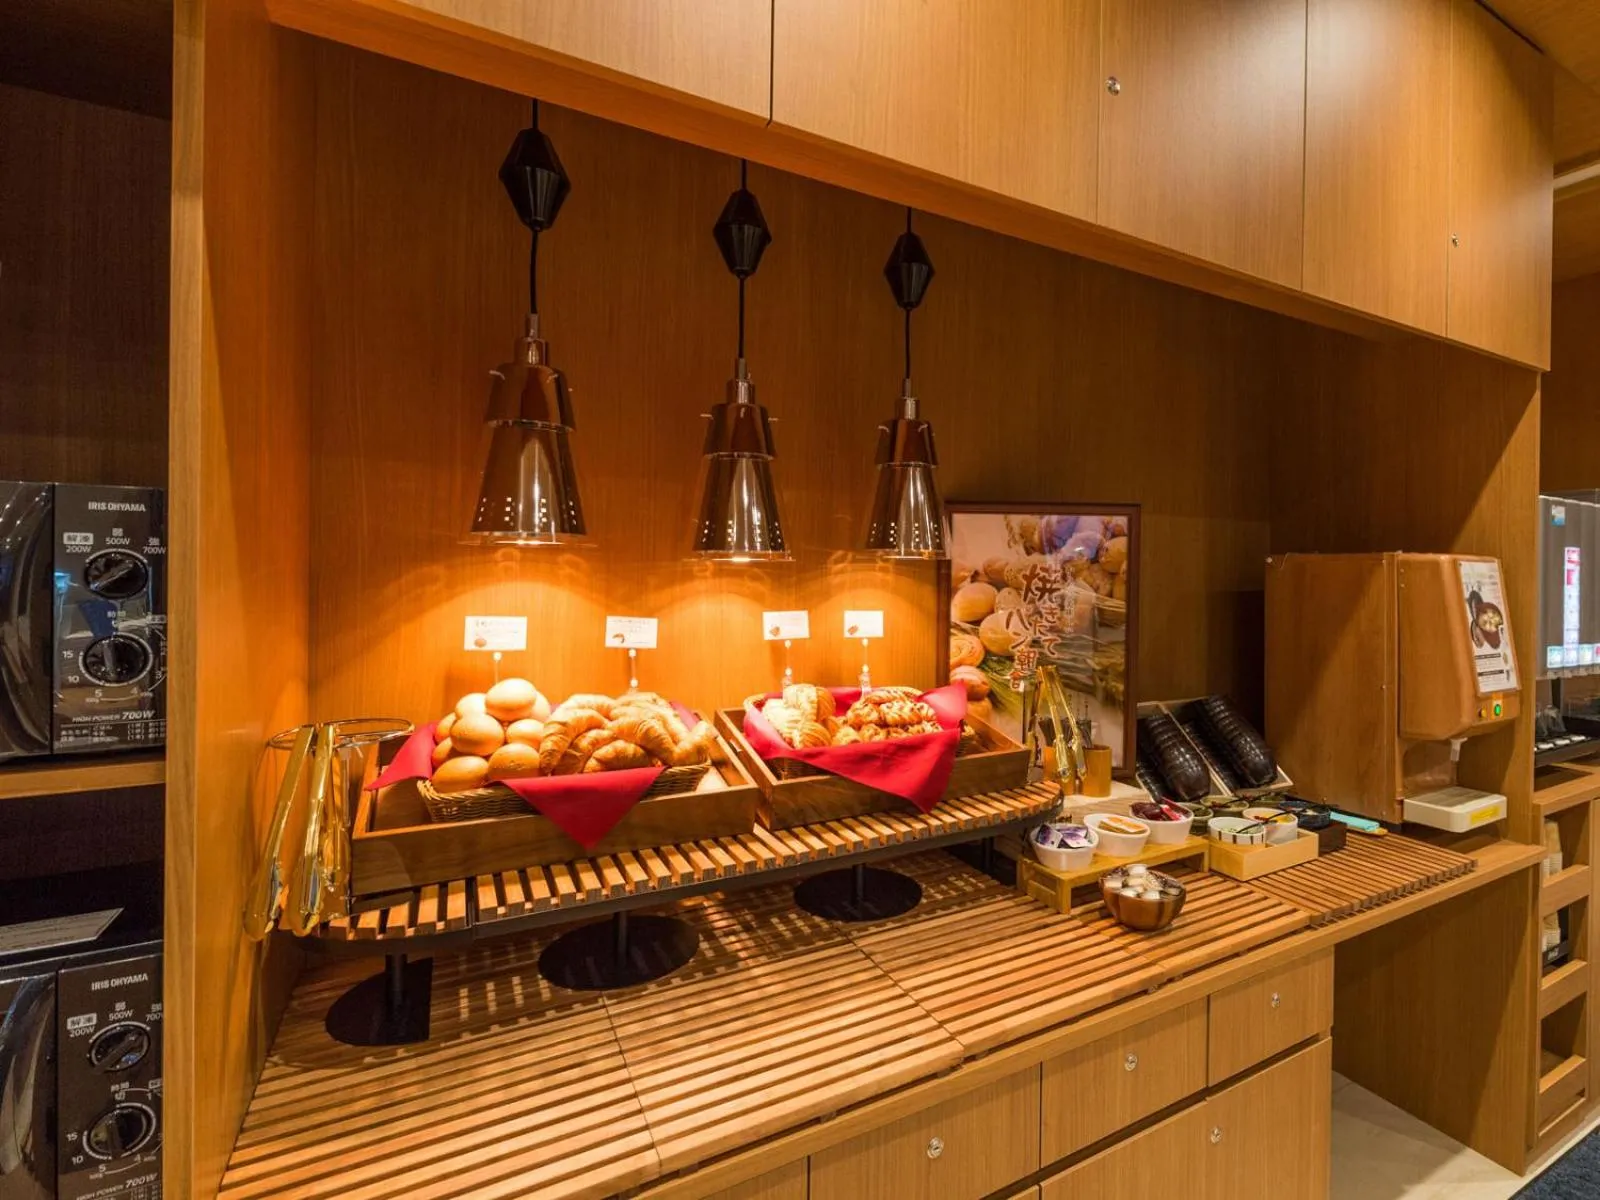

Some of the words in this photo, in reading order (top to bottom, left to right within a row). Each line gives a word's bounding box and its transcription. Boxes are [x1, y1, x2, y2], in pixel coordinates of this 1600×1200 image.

[88, 501, 107, 511] IRIS
[107, 502, 146, 512] OHYAMA
[105, 537, 131, 545] 500W
[66, 545, 92, 553] 200W
[142, 546, 166, 554] 700W
[62, 650, 74, 659] 15
[67, 675, 80, 684] 10
[95, 689, 102, 698] 5
[130, 687, 138, 695] 4
[122, 710, 156, 720] 700W
[91, 980, 109, 991] IRIS
[110, 973, 149, 988] OHYAMA
[109, 1009, 133, 1021] 500W
[70, 1026, 95, 1038] 200W
[67, 1132, 78, 1141] 15
[72, 1155, 84, 1165] 10
[126, 1173, 158, 1188] 700W
